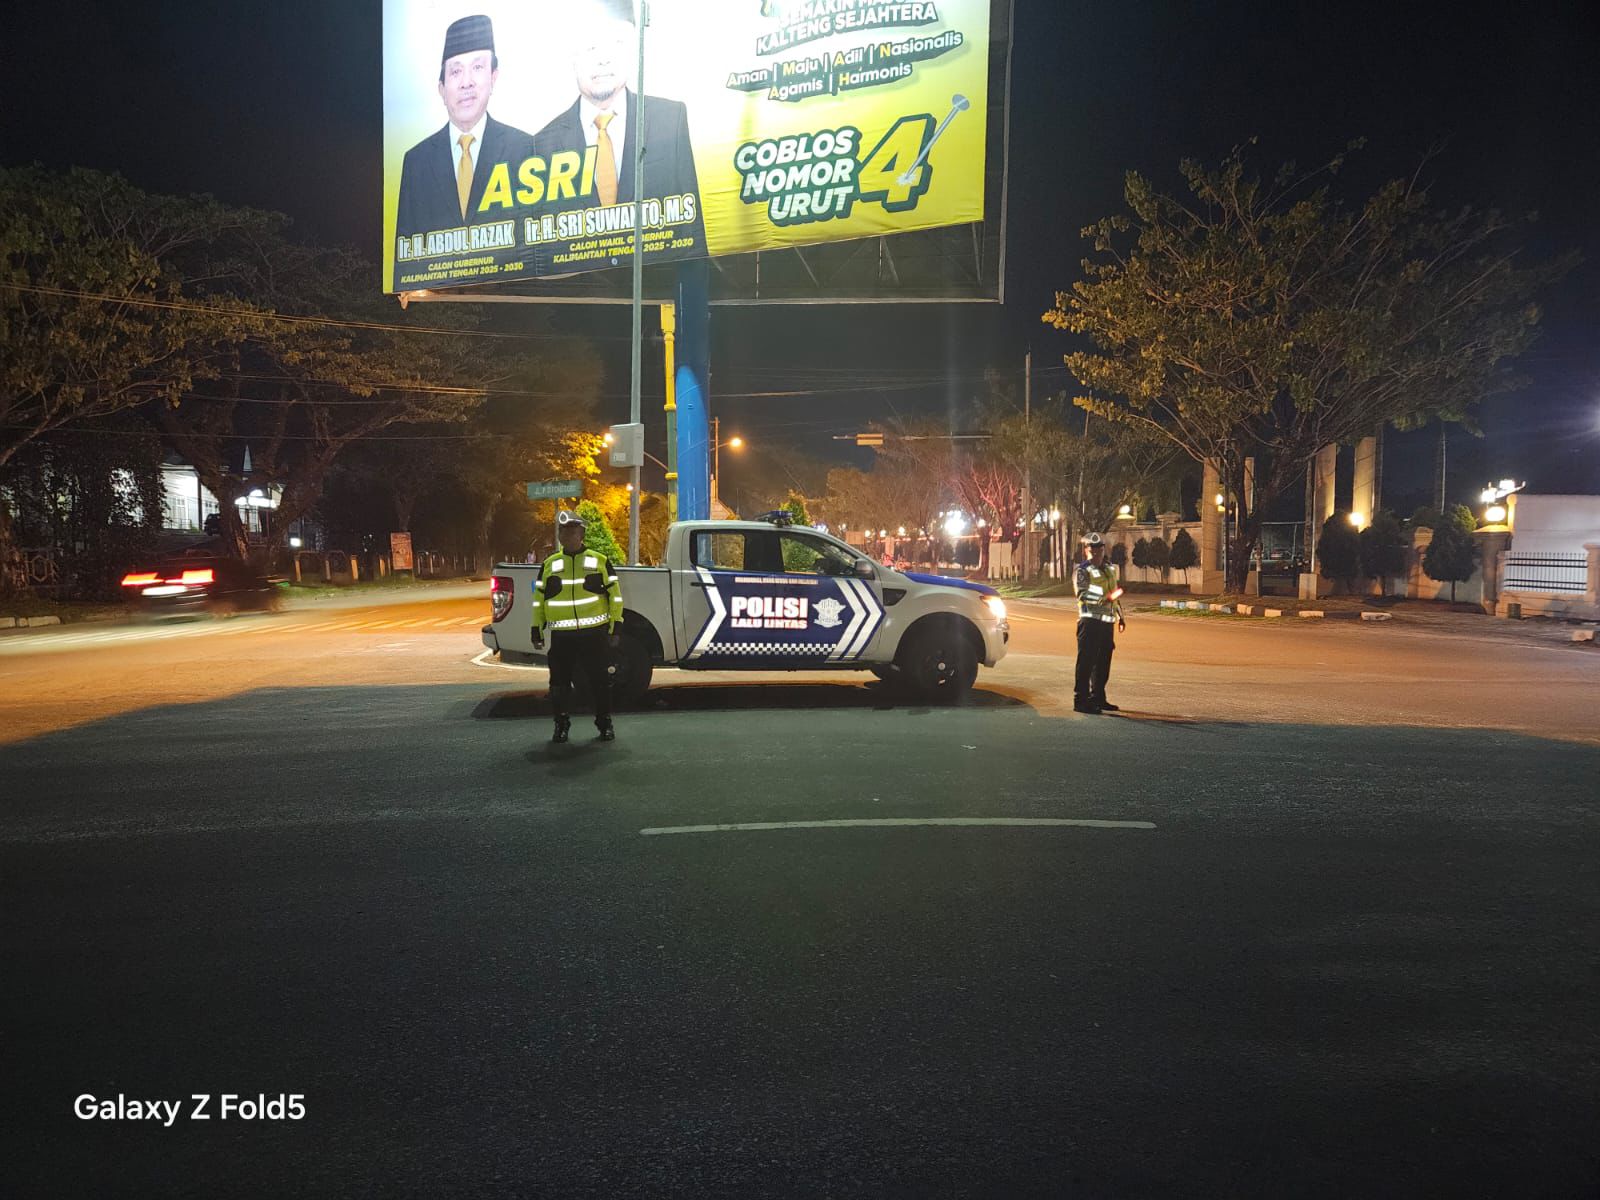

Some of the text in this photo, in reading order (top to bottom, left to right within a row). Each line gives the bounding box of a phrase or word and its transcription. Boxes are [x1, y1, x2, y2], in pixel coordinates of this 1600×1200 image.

[757, 4, 937, 55] KALTENG SEJAHTERA
[727, 68, 768, 87] Aman
[783, 58, 819, 78] Maju
[834, 49, 863, 67] Adil
[879, 32, 962, 58] Nasionalis
[769, 77, 823, 100] Agamis
[839, 63, 911, 86] Harmonis
[736, 129, 855, 170] COBLOS
[858, 117, 930, 205] 4
[478, 146, 598, 212] ASRI
[743, 158, 855, 197] NOMOR
[526, 220, 541, 242] Ir.
[543, 217, 556, 240] H.
[558, 212, 583, 238] SRI
[665, 196, 694, 222] M.S
[770, 185, 854, 220] URUT
[399, 223, 514, 259] Ir. H. ABDUL RAZAK
[553, 249, 606, 263] KALIMANTAN
[608, 245, 635, 257] TENGA
[643, 241, 665, 252] 2025
[671, 238, 693, 249] 2030
[570, 231, 674, 251] CALON WAKIL GBERNUR
[400, 271, 448, 283] KALIMANTAN
[449, 267, 480, 278] TENGAH
[480, 264, 499, 274] 2025
[504, 262, 524, 272] 2030
[428, 256, 494, 271] CALON GUBERNUR
[731, 596, 808, 618] POLISI
[731, 618, 808, 629] LALU LINTAS
